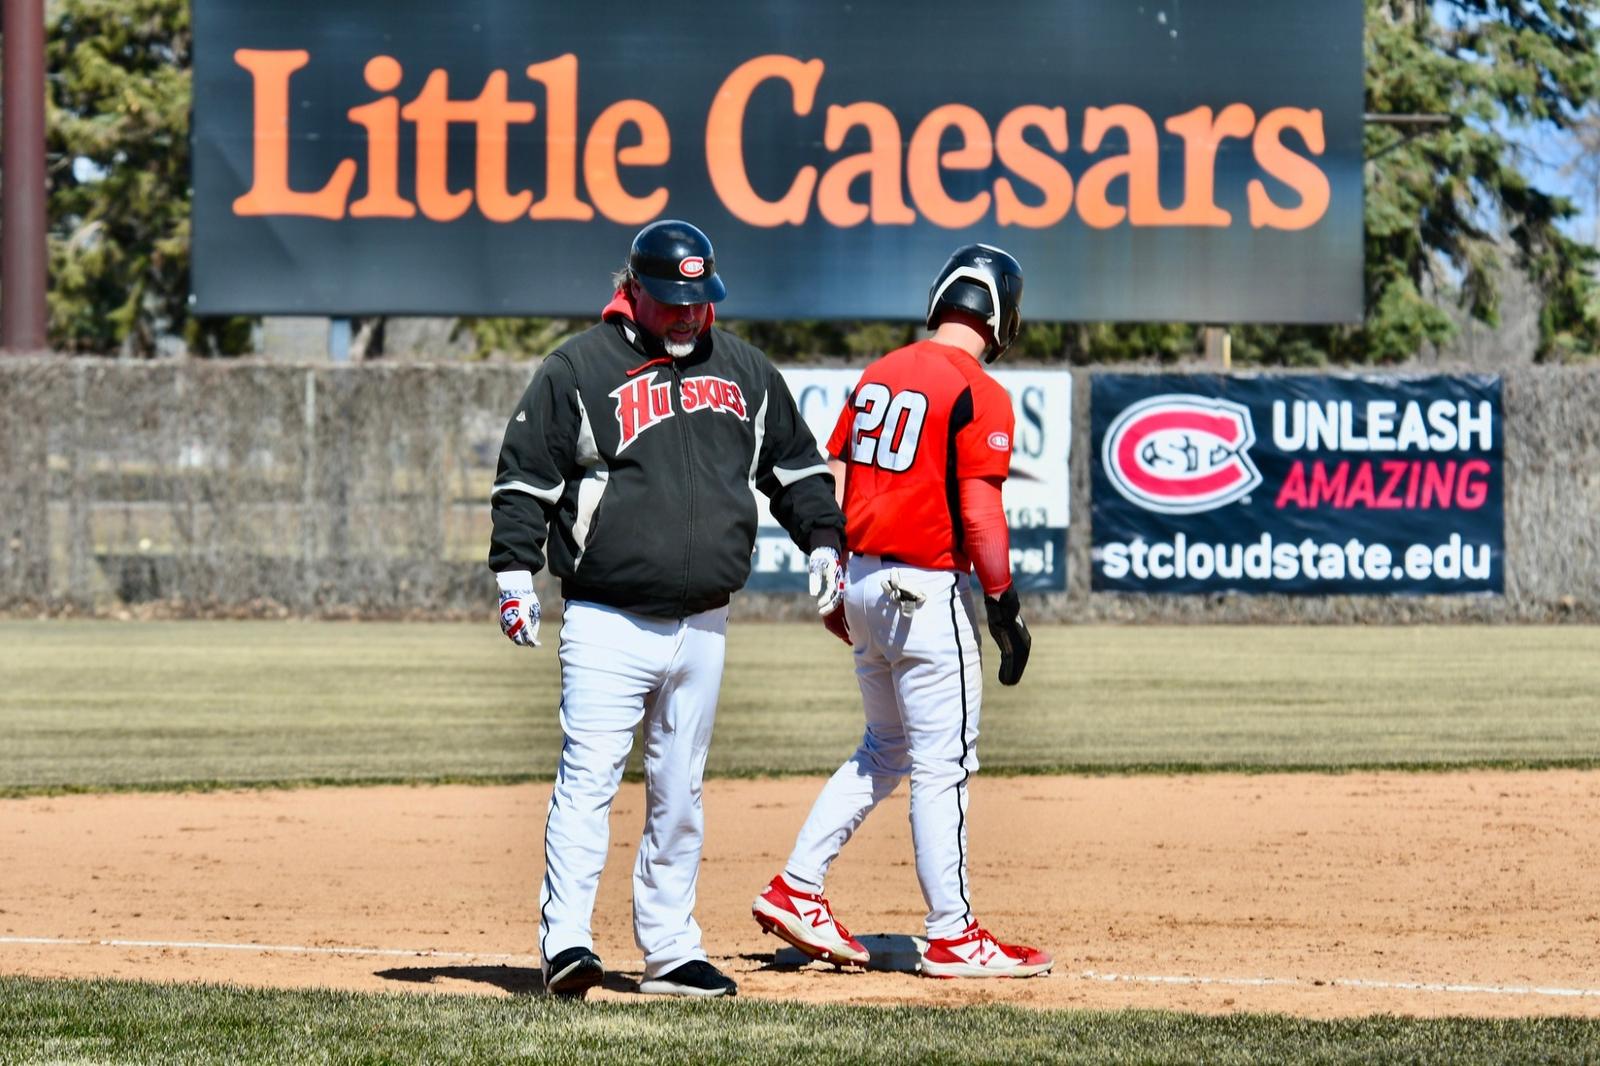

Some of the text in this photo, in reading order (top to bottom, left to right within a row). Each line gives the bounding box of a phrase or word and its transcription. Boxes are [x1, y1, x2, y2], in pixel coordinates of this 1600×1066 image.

[233, 48, 1331, 230] Little Caesars
[851, 382, 929, 473] 20
[1272, 399, 1493, 452] UNLEASH
[1275, 459, 1491, 510] AMAZING
[1102, 532, 1492, 581] stcloudstate.edu
